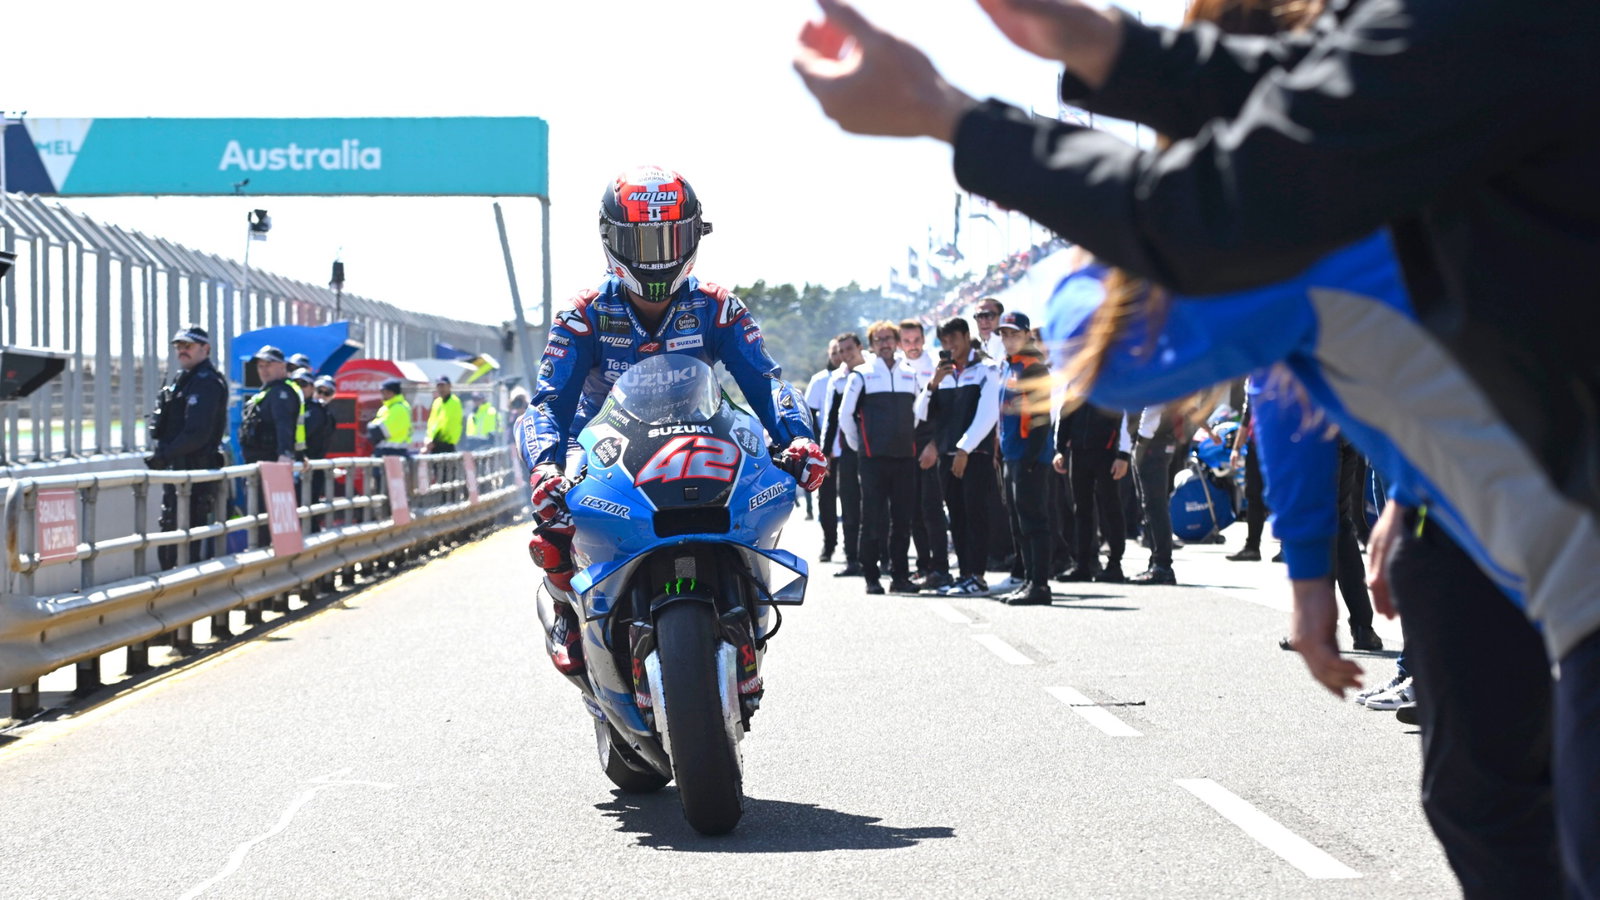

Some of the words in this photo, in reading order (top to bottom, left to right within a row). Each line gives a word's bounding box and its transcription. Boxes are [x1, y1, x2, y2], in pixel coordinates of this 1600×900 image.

[218, 139, 382, 171] Australia
[628, 191, 678, 206] NOLAN
[599, 336, 633, 347] NOLAN
[676, 338, 701, 347] SUZUKI
[545, 346, 565, 358] OTUL
[606, 358, 641, 372] Team
[648, 425, 714, 438] SUZUKI
[635, 435, 740, 485] 42
[749, 483, 786, 511] ECSTAR
[580, 496, 630, 518] ECSTAR
